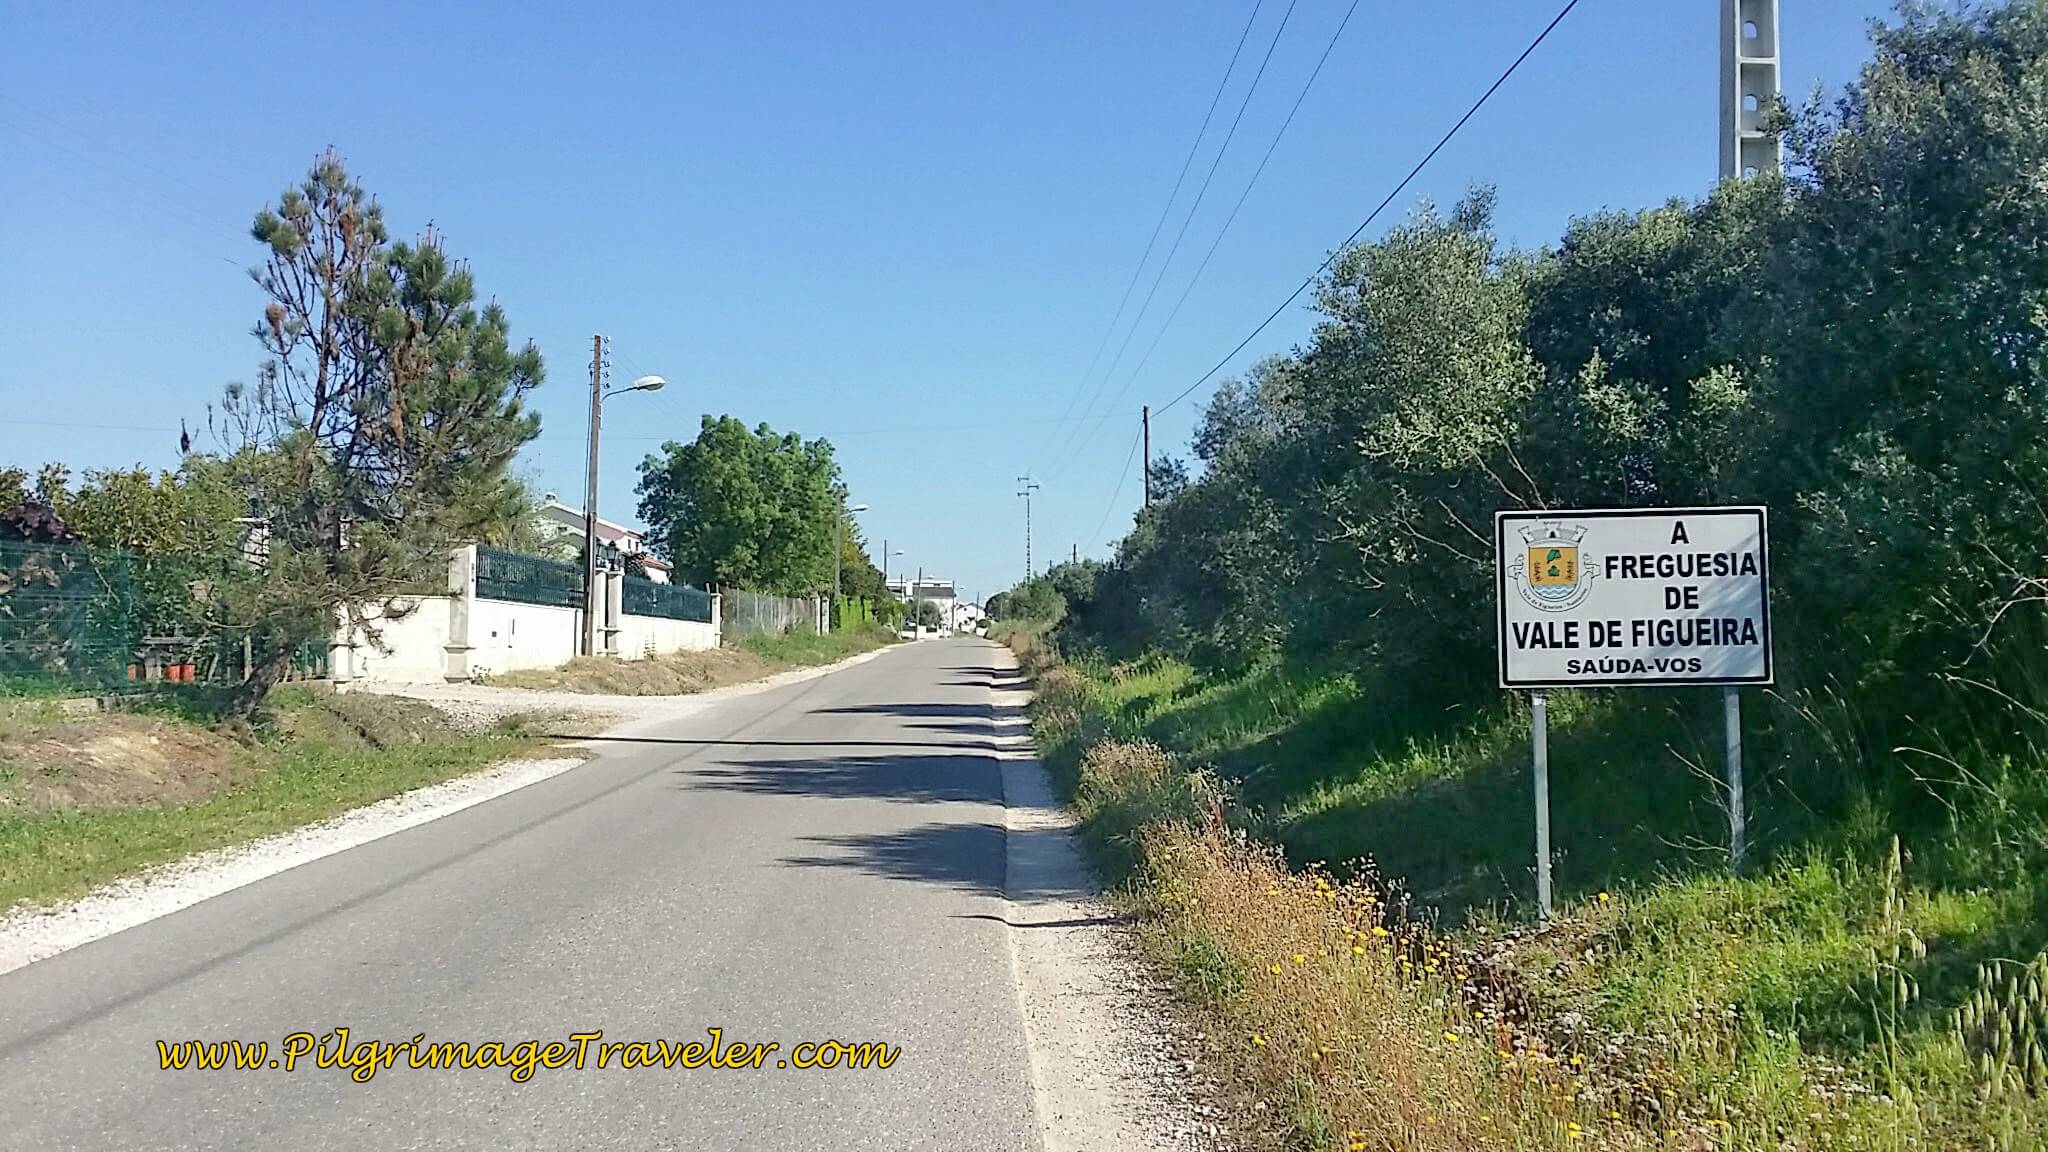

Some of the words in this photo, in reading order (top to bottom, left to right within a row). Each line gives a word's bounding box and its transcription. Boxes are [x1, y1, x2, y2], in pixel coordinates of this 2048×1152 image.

[1671, 521, 1689, 545] A
[1605, 552, 1757, 579] FREGUESIA
[1665, 586, 1699, 610] DE
[1512, 621, 1579, 649] VALE
[1589, 620, 1622, 648] DE
[1632, 618, 1758, 647] FIGUEIRA
[1567, 656, 1702, 674] SAÚDA-VOS
